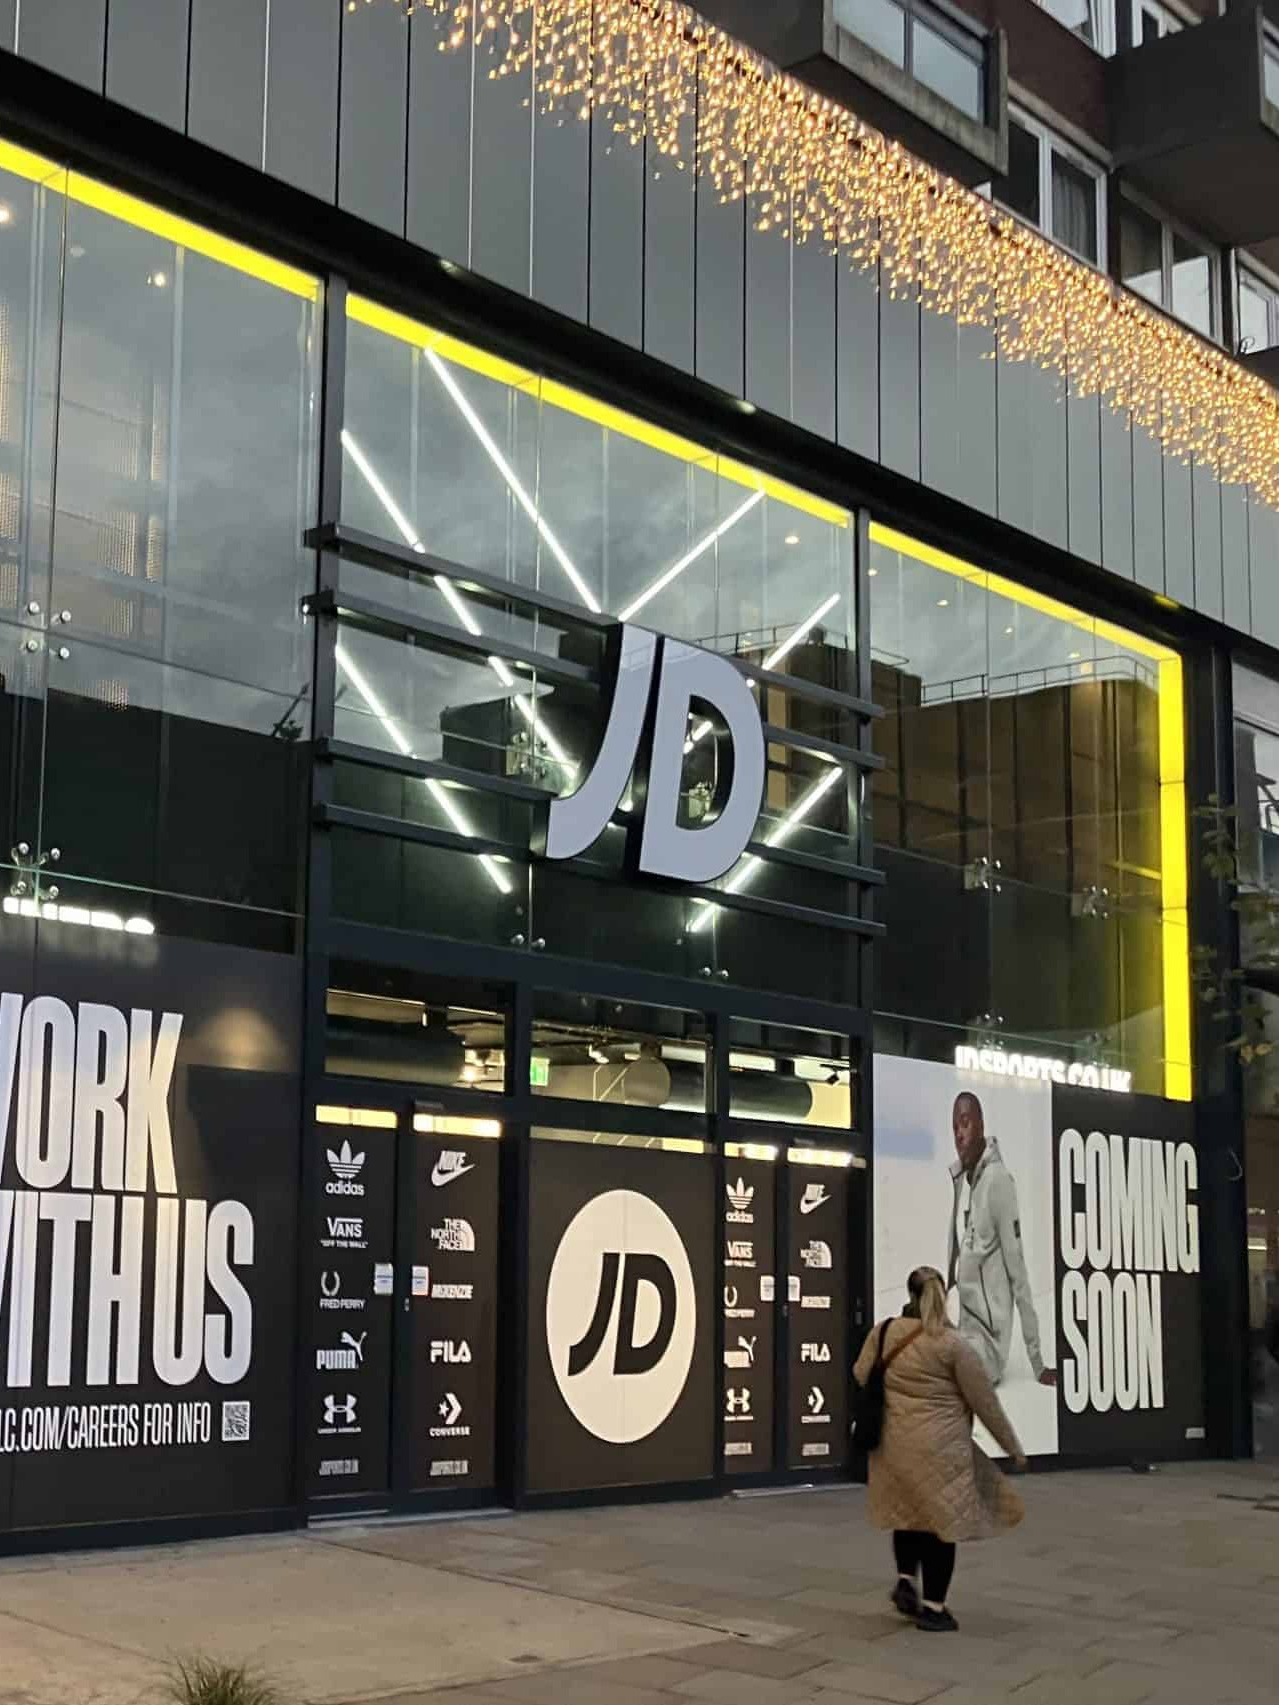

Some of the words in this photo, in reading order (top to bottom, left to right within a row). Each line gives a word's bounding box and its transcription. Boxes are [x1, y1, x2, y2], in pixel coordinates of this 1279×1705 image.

[546, 623, 766, 883] JD
[325, 1180, 364, 1196] adidas
[1059, 1128, 1200, 1273] COMING
[327, 1216, 363, 1238] VANS
[153, 1198, 255, 1386] US
[568, 1252, 677, 1376] JD
[316, 1349, 357, 1369] PUMA
[430, 1340, 472, 1363] FILA
[801, 1343, 831, 1362] FILA
[1061, 1270, 1164, 1414] SOON
[143, 1403, 172, 1446] FOR
[177, 1402, 211, 1444] INFO
